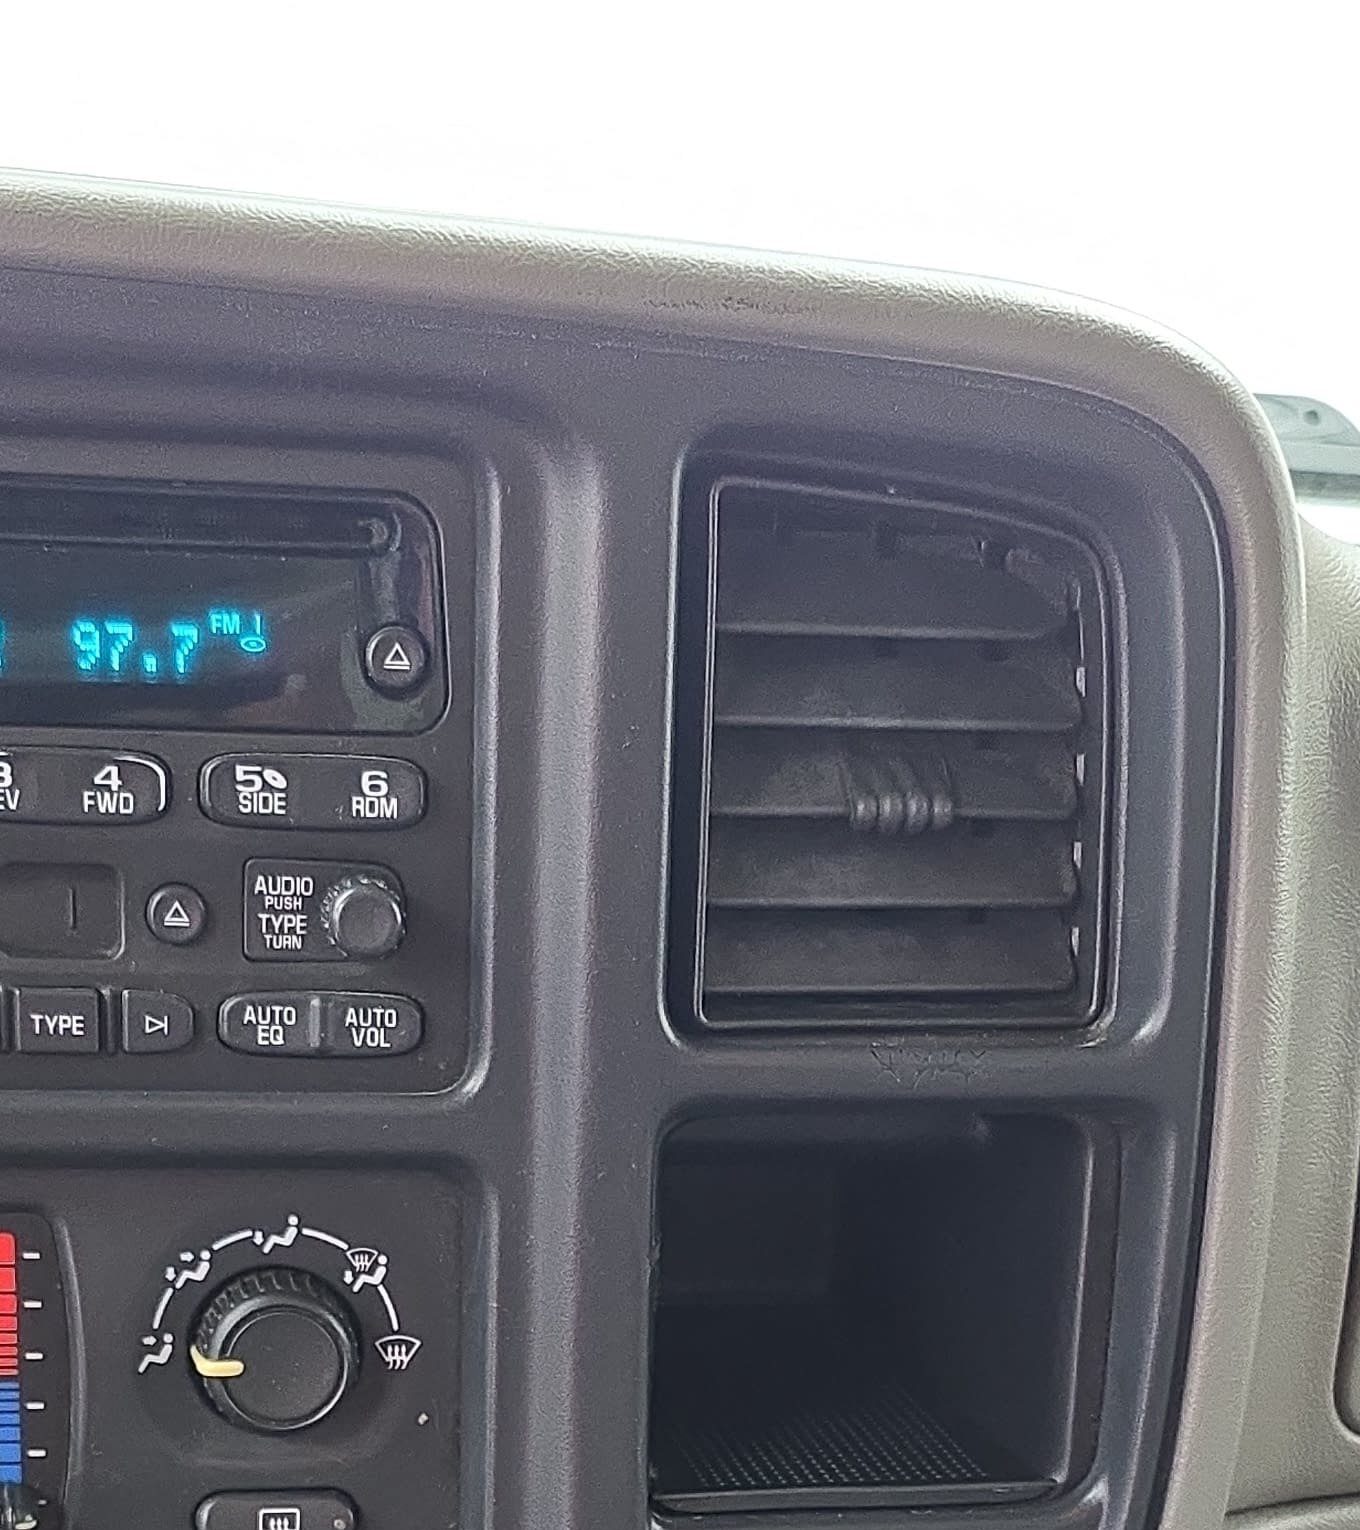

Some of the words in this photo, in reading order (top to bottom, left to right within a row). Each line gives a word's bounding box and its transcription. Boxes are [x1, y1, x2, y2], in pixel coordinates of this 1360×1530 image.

[72, 619, 200, 673] 97.7
[94, 766, 122, 792] 4
[234, 766, 262, 794] 5
[359, 770, 388, 796] 6
[83, 790, 134, 814] FWD
[238, 794, 286, 816] SIDE
[352, 797, 398, 820] RDM
[254, 876, 314, 897] AUDIO
[264, 896, 303, 911] PUSH
[257, 913, 308, 935] TYPE
[264, 934, 303, 950] TURN
[30, 1014, 85, 1036] TYPE
[243, 1005, 297, 1026] AUTO
[344, 1006, 397, 1028] AUTO
[257, 1025, 284, 1046] EQ
[351, 1028, 391, 1048] VOL
